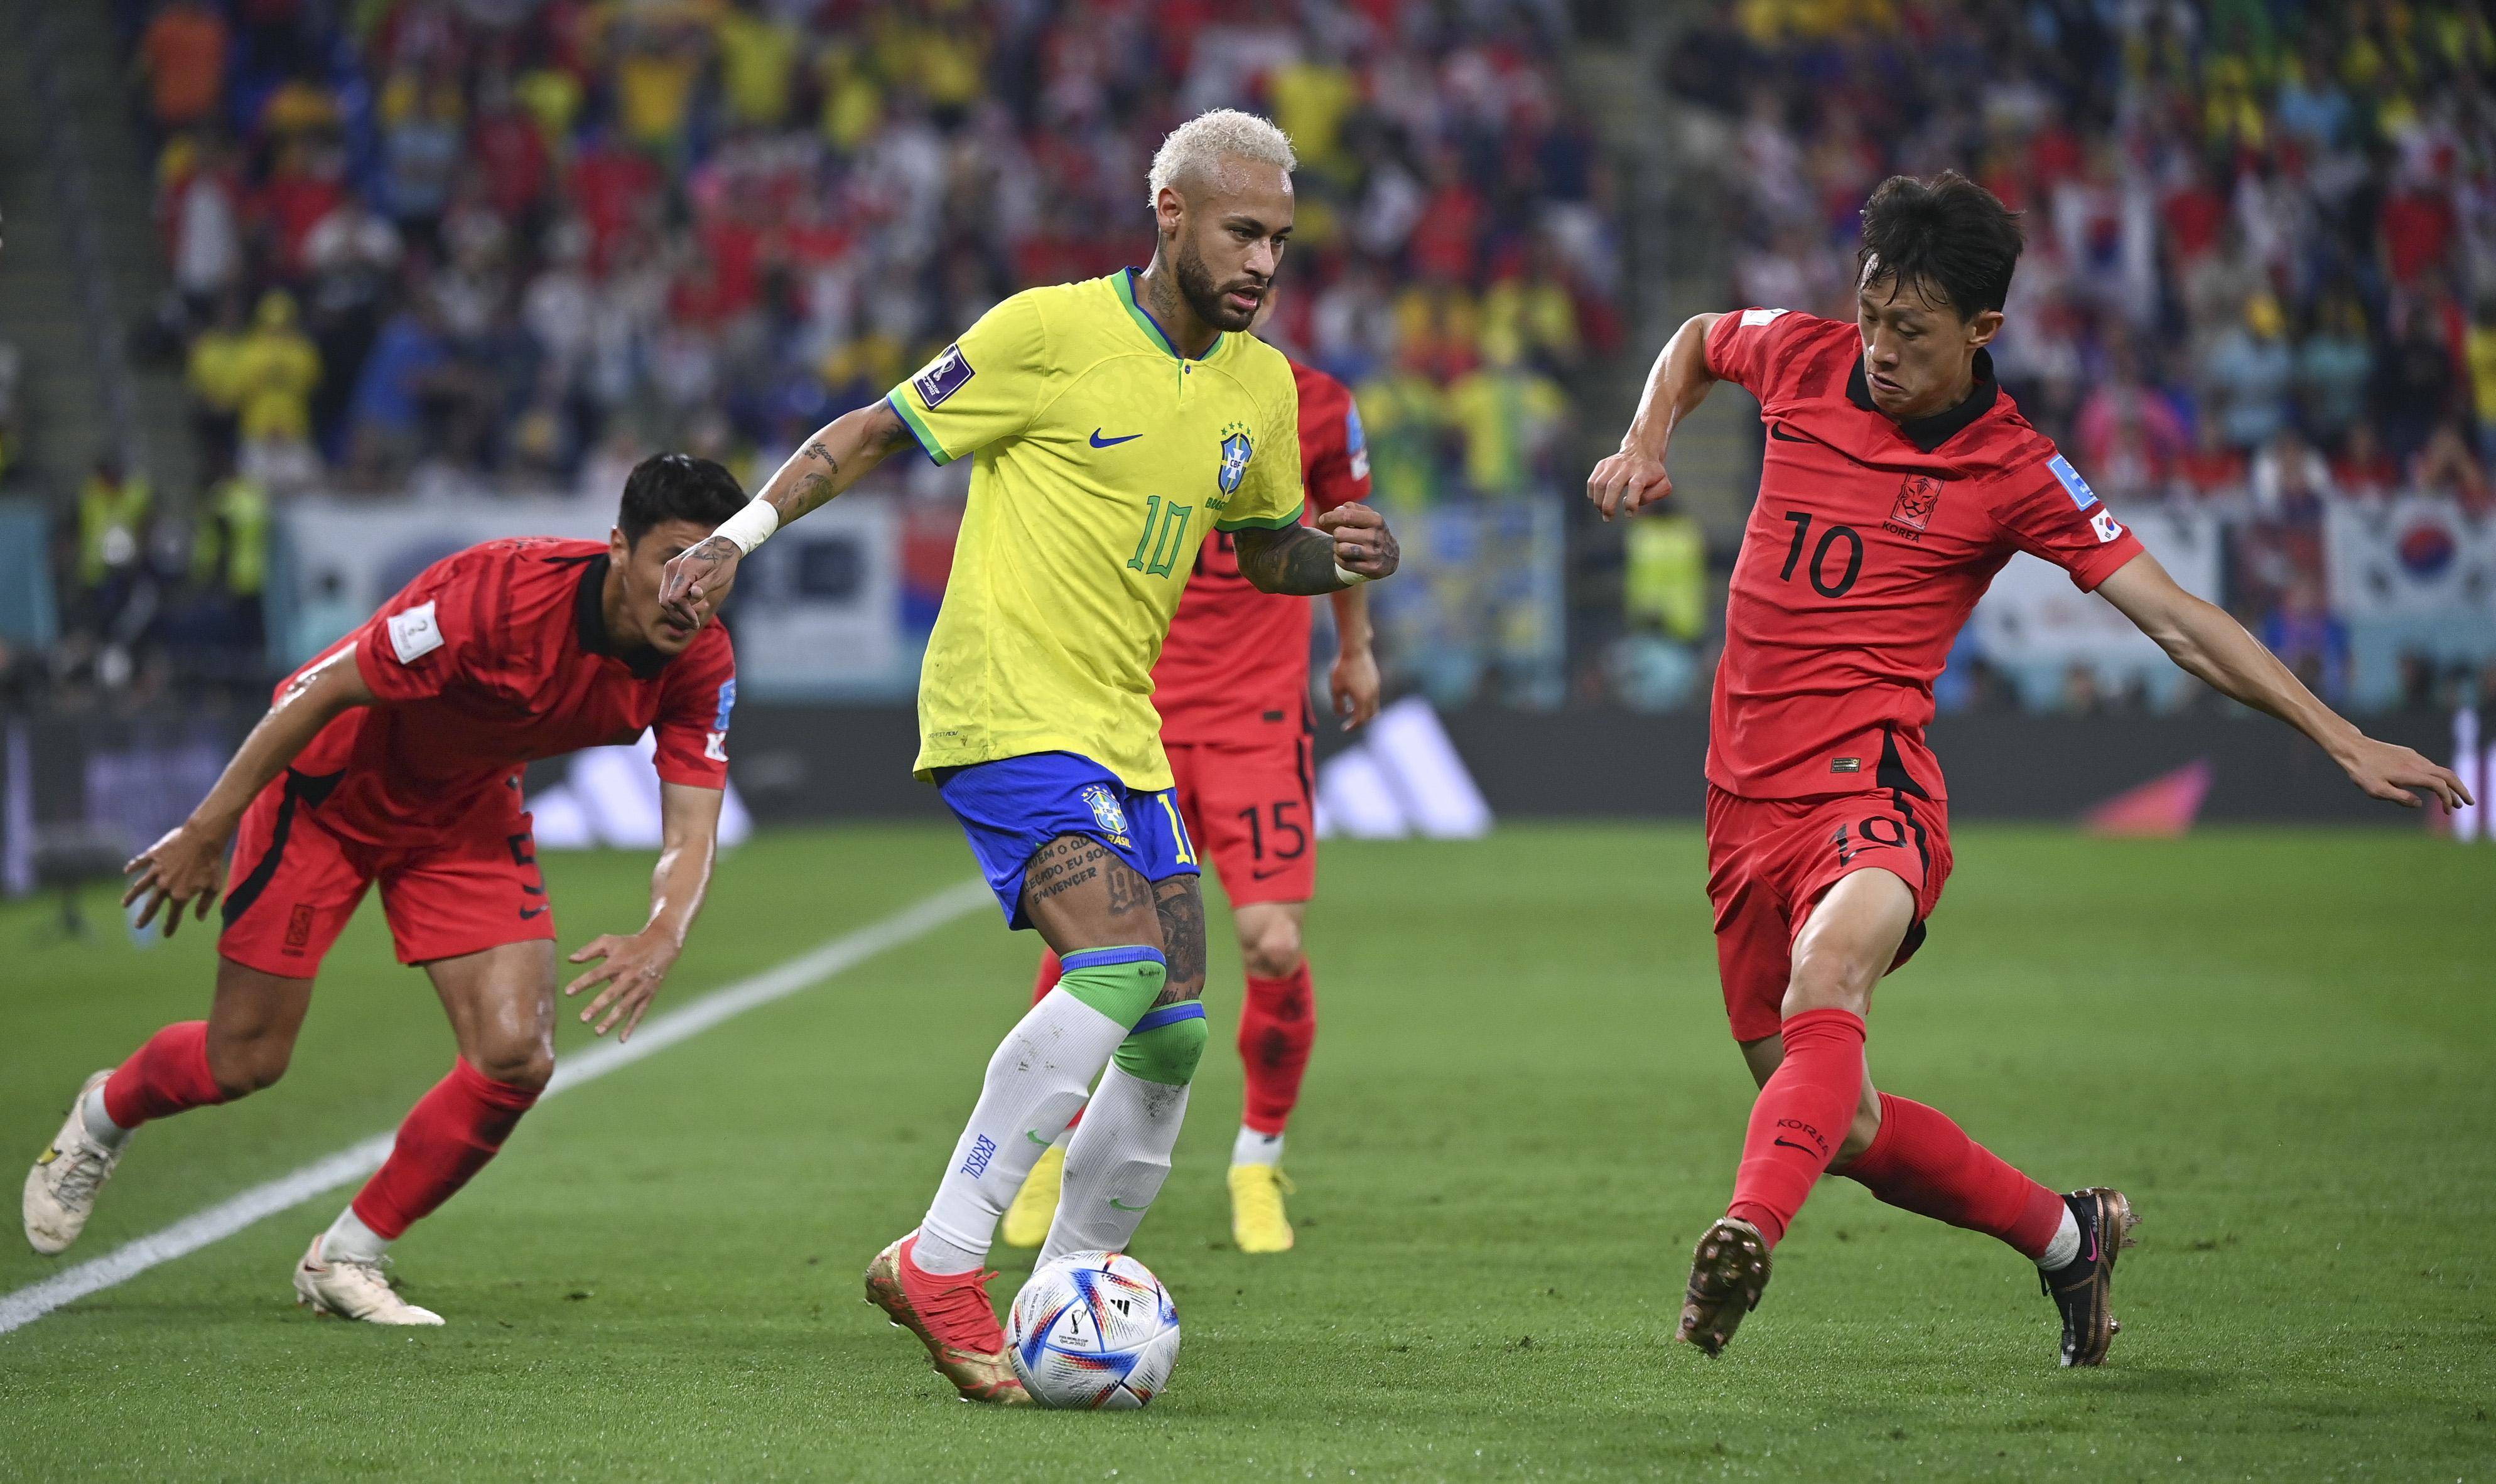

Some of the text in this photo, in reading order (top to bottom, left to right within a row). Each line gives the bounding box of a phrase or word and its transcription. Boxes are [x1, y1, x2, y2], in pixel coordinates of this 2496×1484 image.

[1230, 459, 1241, 468] CBF
[1126, 495, 1193, 579] 10
[1882, 520, 1921, 544] KOREA
[1779, 510, 1864, 599] 10
[1157, 793, 1198, 866] 1
[1238, 800, 1306, 860] 15
[1049, 867, 1097, 896] VENCER
[1066, 854, 1083, 871] EU
[961, 1133, 997, 1180] BRASIL
[1777, 1119, 1830, 1156] KOREA
